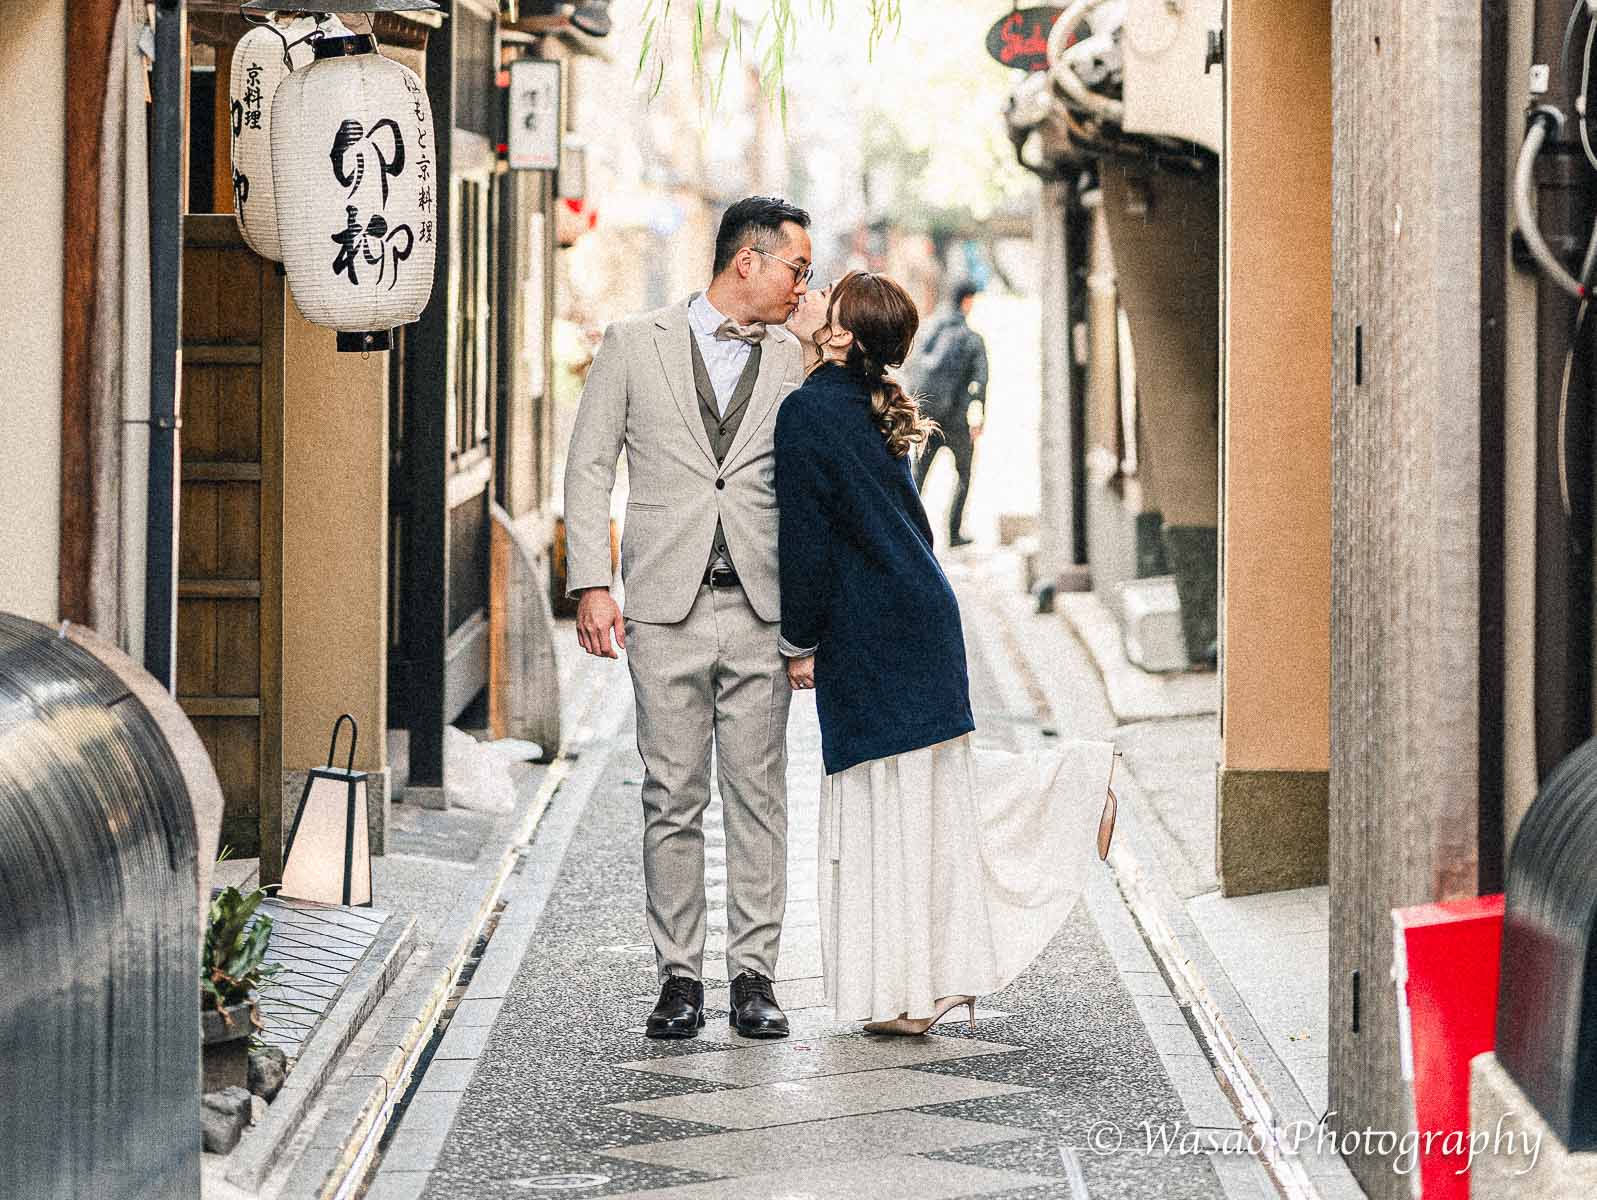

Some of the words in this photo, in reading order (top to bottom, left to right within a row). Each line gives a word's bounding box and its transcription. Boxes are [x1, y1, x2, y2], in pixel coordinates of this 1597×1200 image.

[243, 62, 264, 131] 京料理
[329, 118, 415, 292] 卯柳
